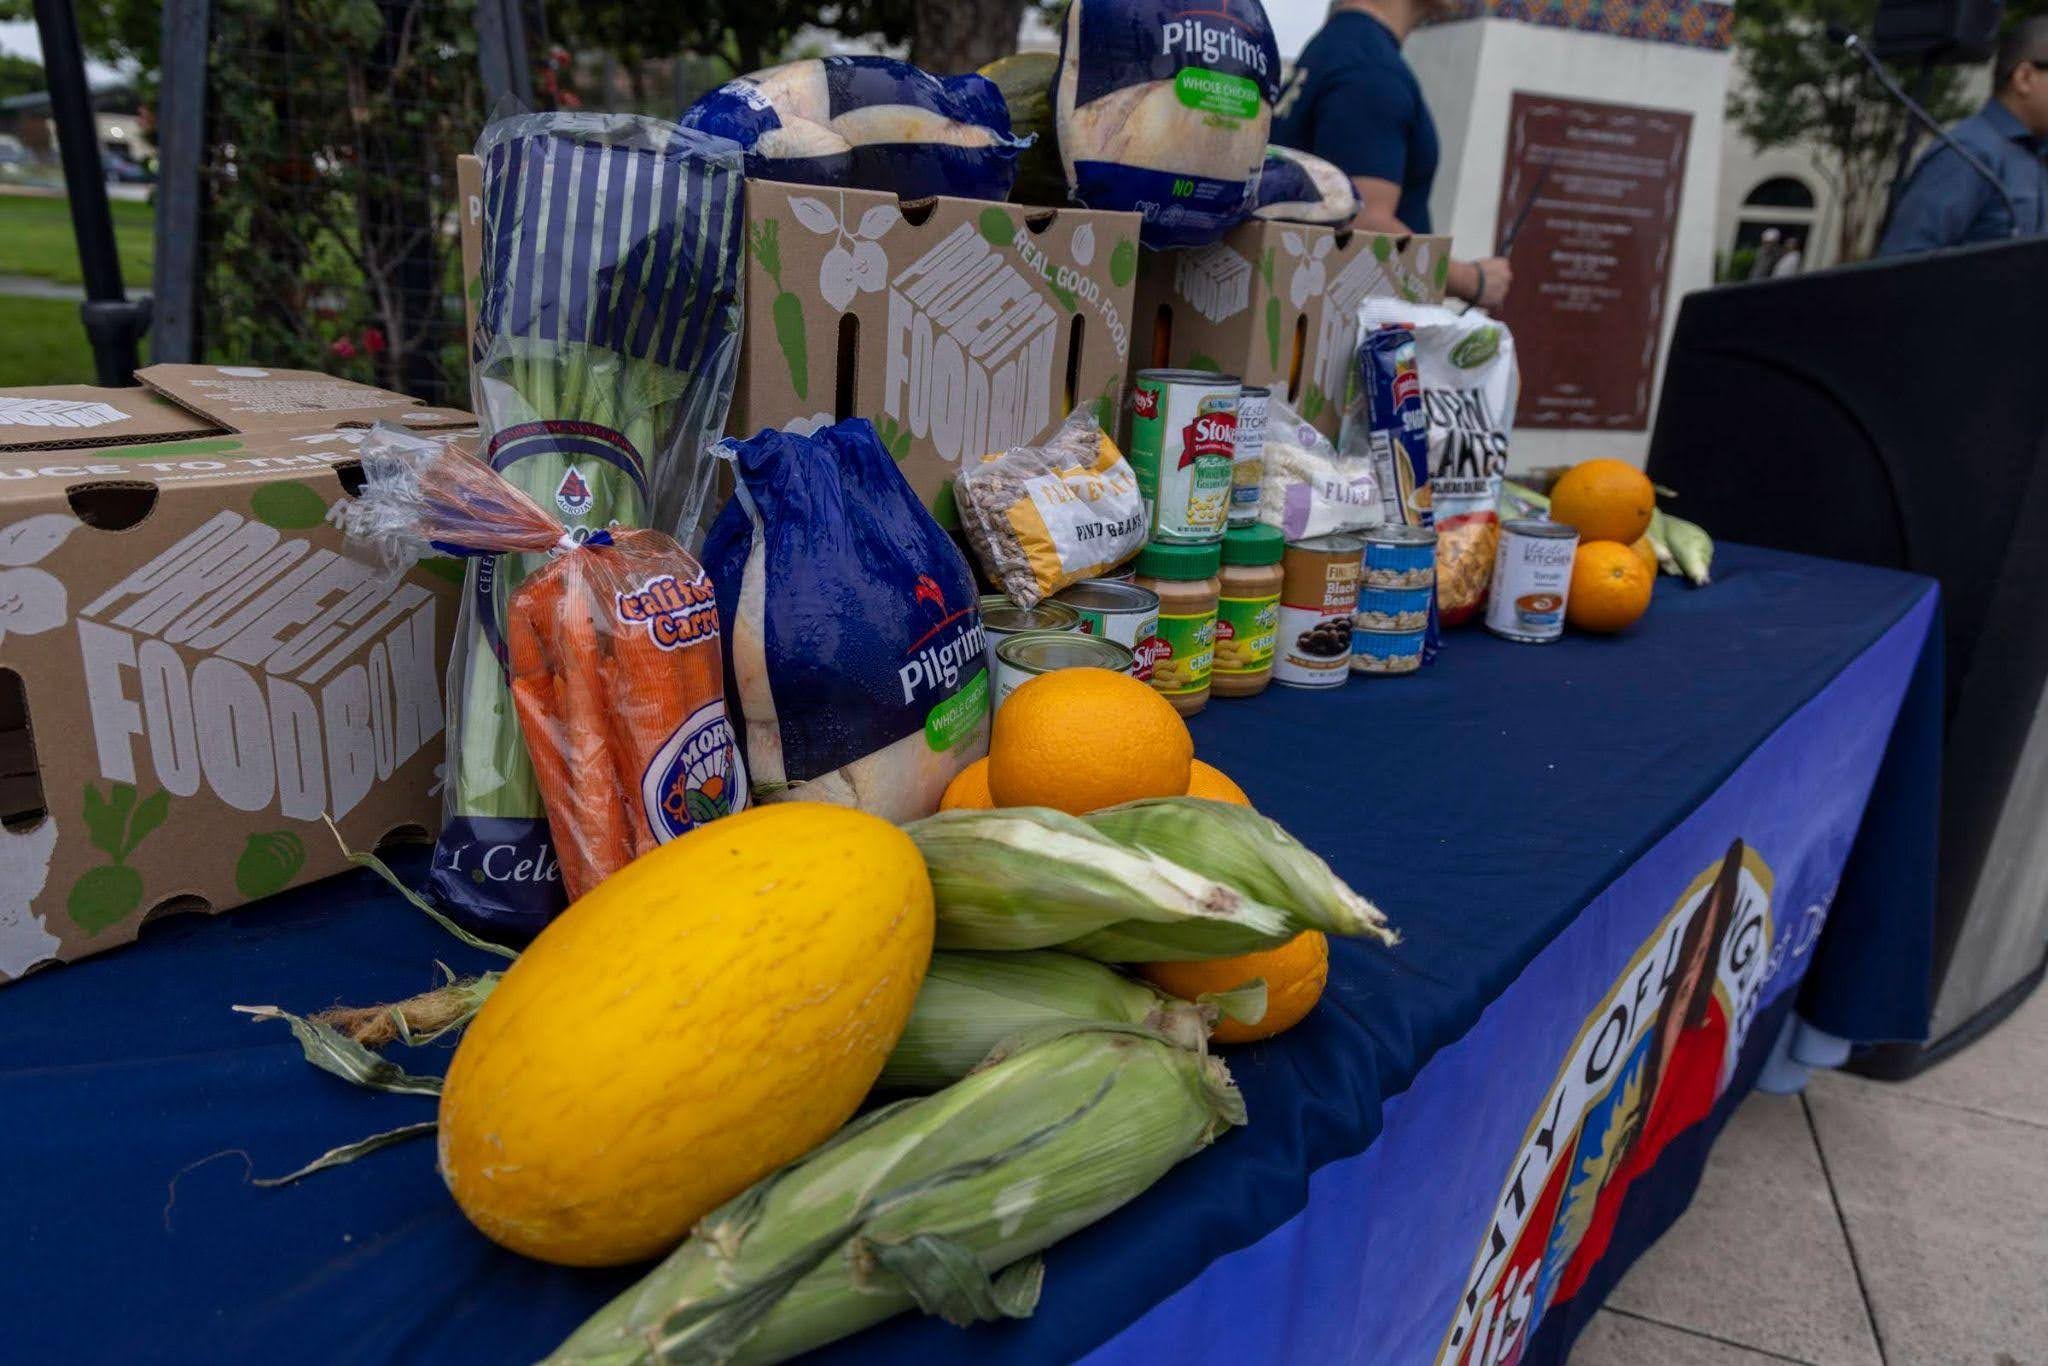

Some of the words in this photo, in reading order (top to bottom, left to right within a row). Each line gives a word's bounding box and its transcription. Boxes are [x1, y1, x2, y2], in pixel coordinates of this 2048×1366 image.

[1162, 19, 1267, 76] Pilgrim's
[1182, 77, 1222, 95] WHOLE
[1172, 178, 1194, 197] NO
[1013, 227, 1053, 281] REAL.
[137, 461, 227, 474] TO
[235, 450, 353, 467] THE
[1585, 960, 1654, 1085] OF
